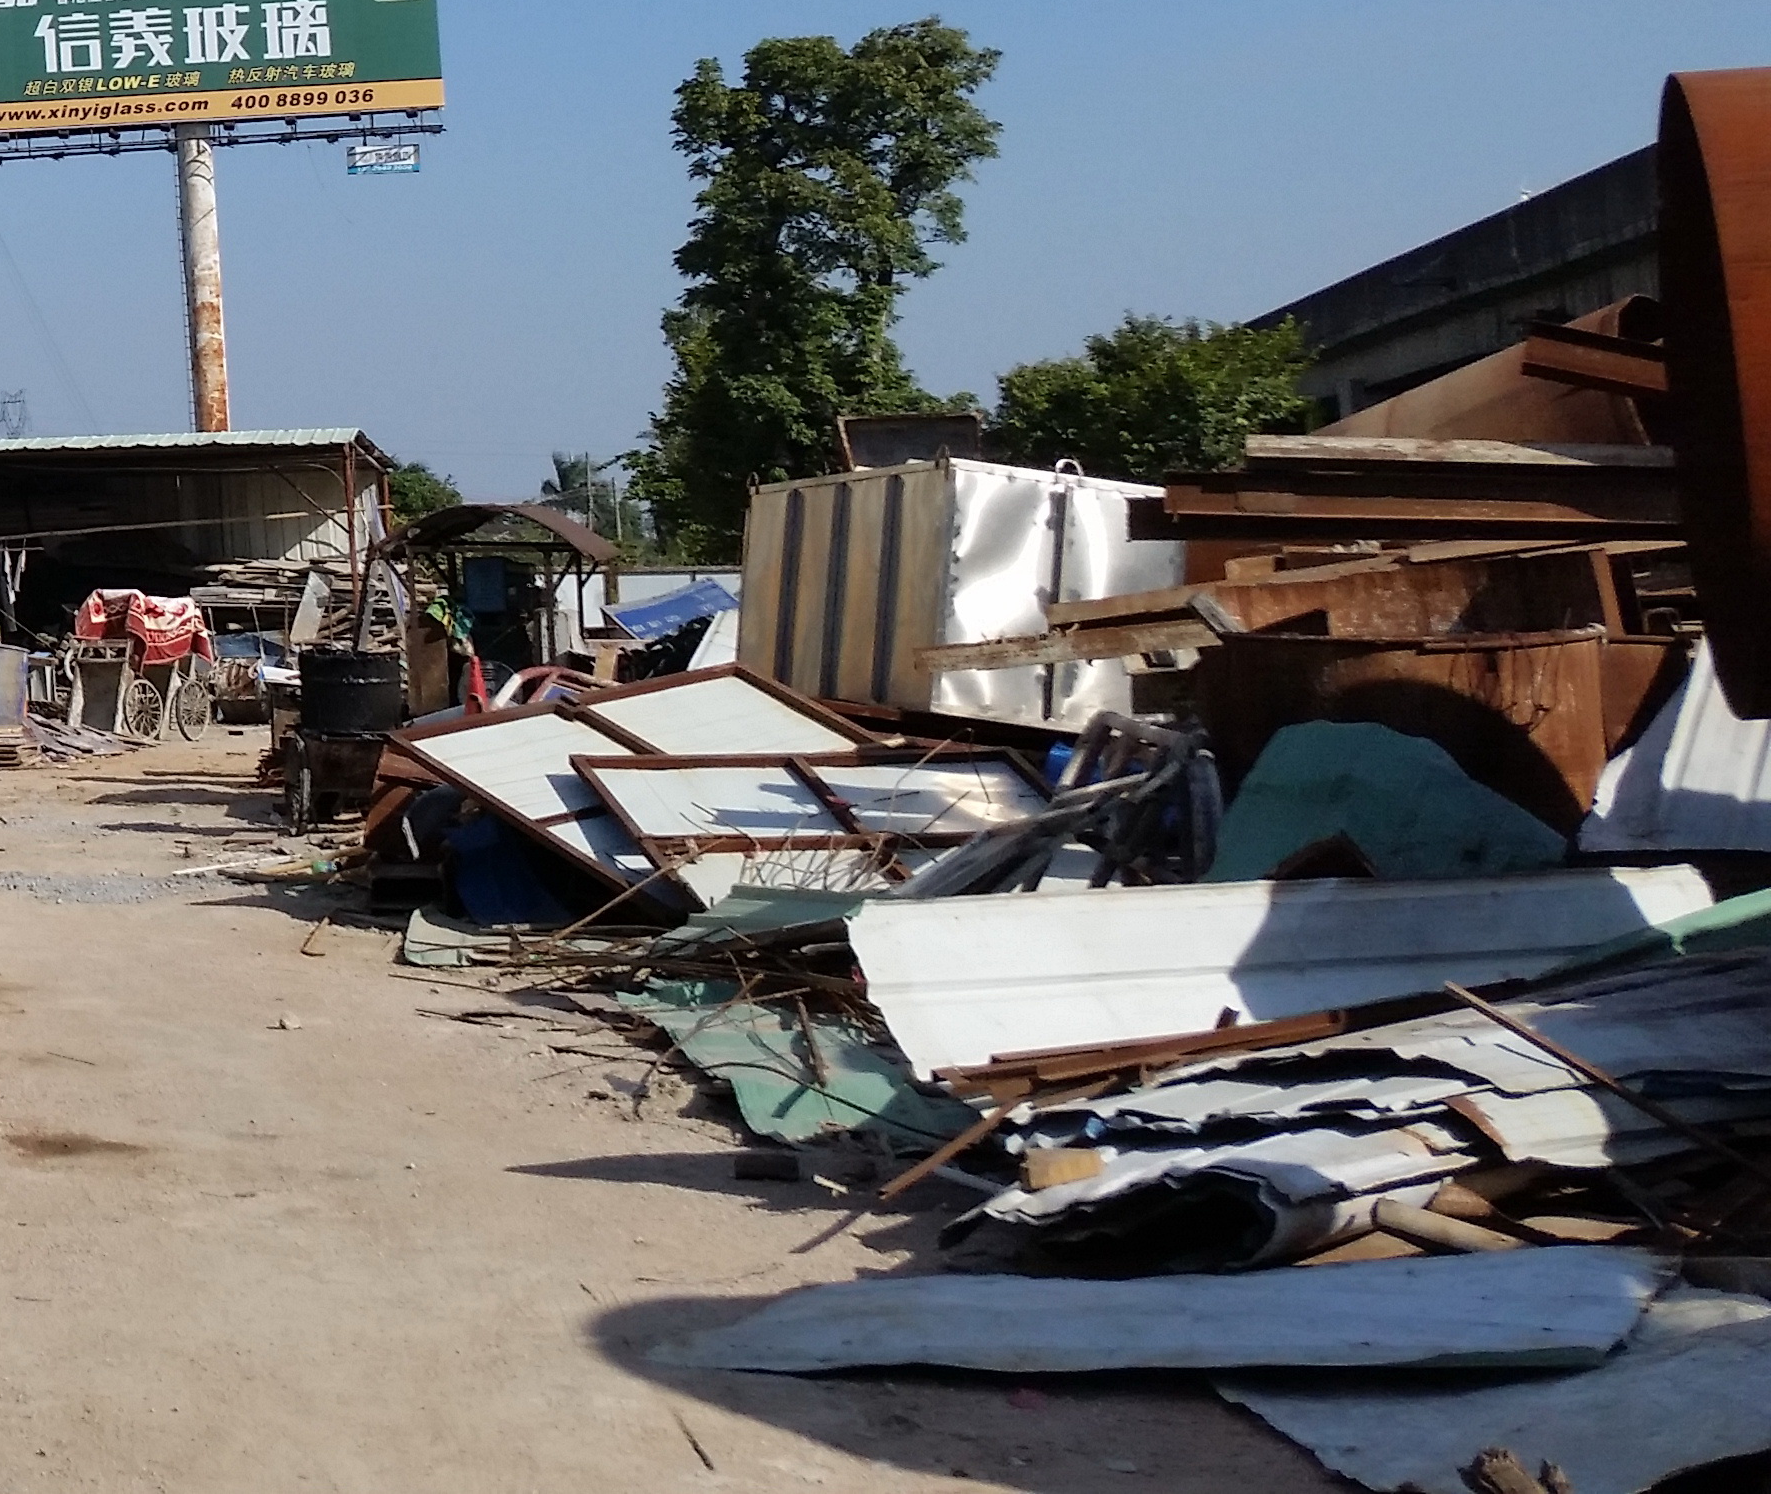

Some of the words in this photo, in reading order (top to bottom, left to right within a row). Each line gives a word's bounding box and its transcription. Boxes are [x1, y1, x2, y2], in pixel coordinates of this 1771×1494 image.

[227, 61, 356, 84] 热反射汽车玻璃
